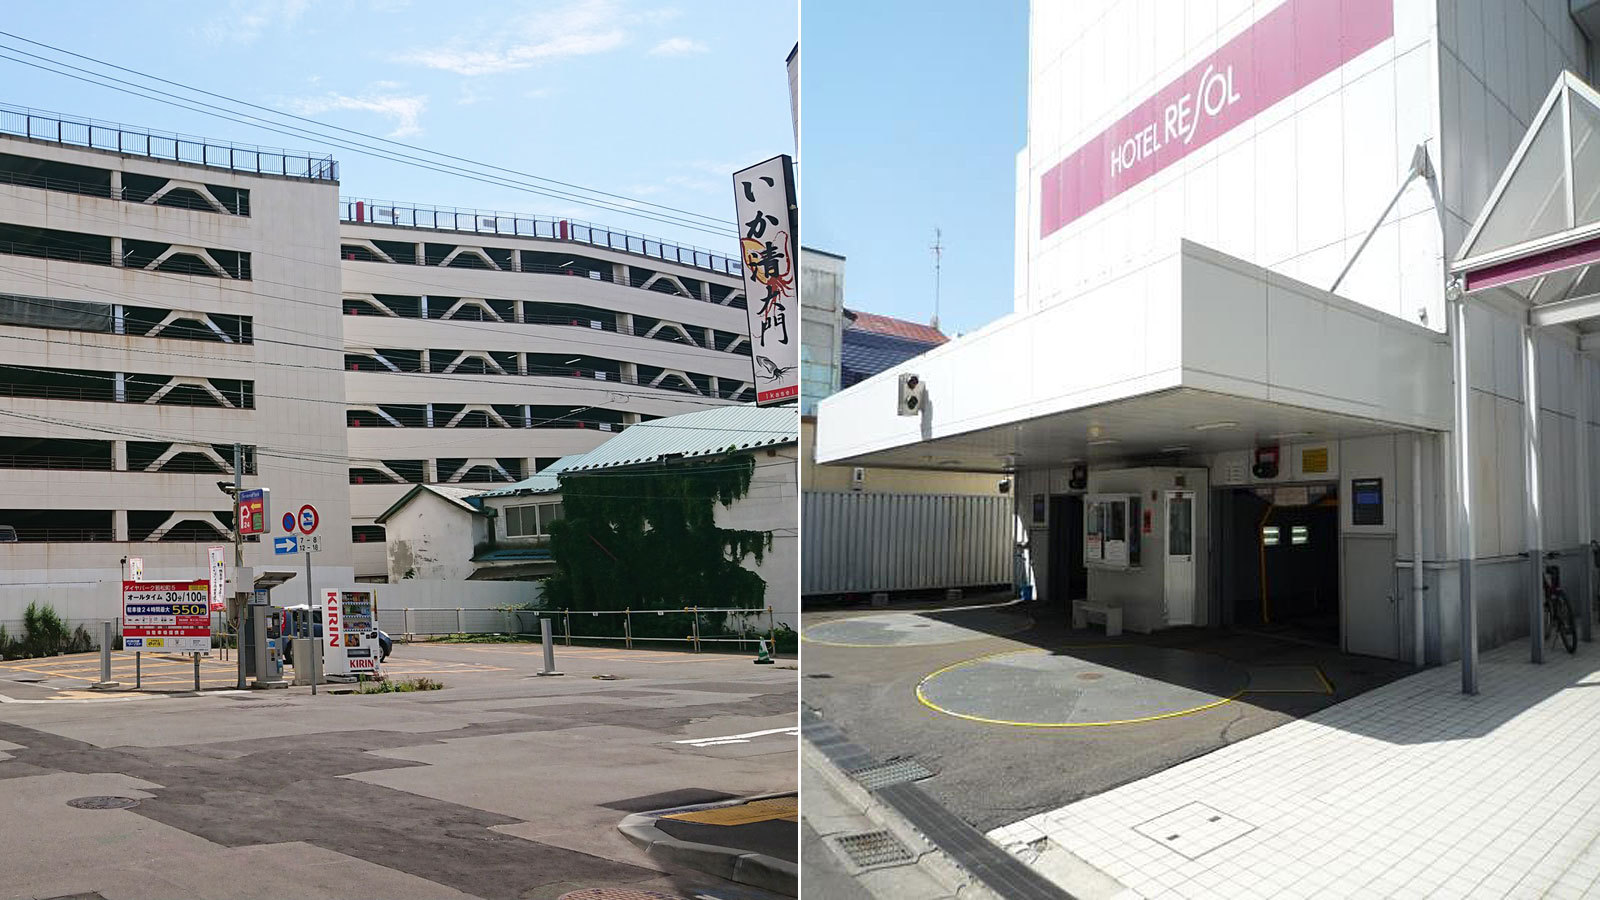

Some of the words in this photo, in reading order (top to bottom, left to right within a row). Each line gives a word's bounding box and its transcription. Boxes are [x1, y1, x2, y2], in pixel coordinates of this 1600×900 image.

[1110, 123, 1161, 178] HOTEL
[1164, 63, 1241, 145] RESOL
[741, 175, 789, 347] いか清大門
[765, 387, 795, 399] Ikasei
[127, 593, 163, 601] オールタイム
[165, 591, 207, 602] 30分/100円
[172, 604, 206, 615] 550円
[327, 591, 340, 648] KIRIN
[349, 659, 374, 669] KIRIN
